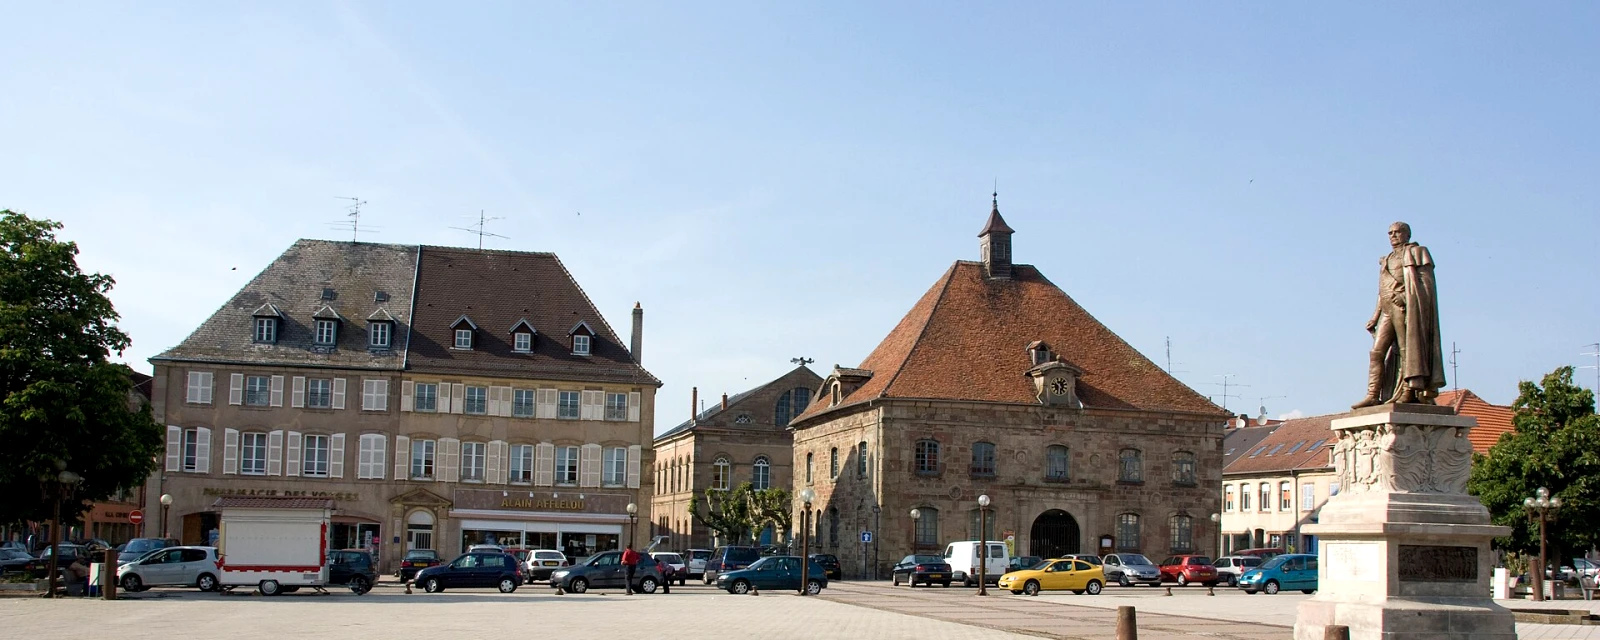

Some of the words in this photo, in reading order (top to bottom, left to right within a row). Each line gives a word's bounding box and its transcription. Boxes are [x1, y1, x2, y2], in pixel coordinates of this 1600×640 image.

[203, 488, 277, 497] PHARMACIE
[501, 499, 531, 508] ALAIN
[537, 500, 584, 509] AFFLELOU
